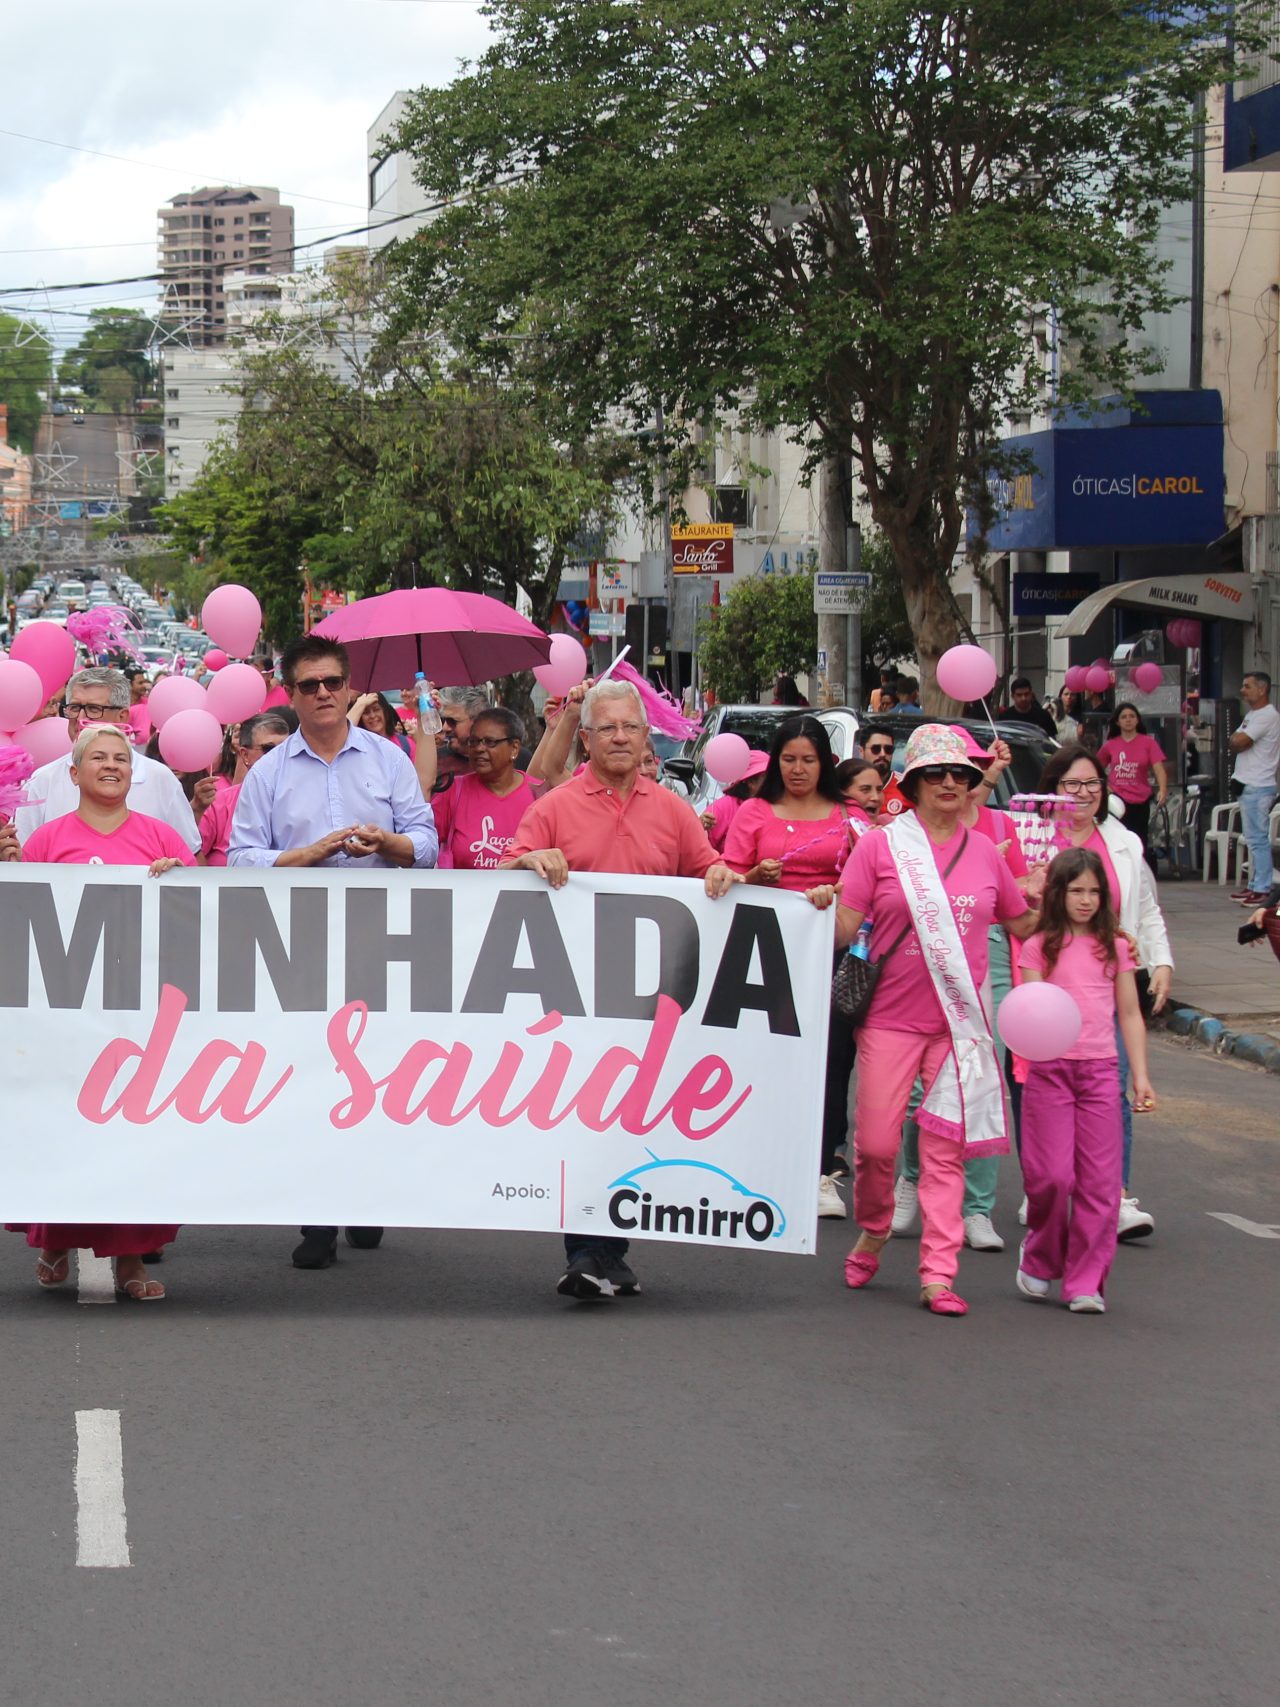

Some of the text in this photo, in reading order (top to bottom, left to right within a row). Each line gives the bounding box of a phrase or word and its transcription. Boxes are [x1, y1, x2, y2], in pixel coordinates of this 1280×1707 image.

[1072, 474, 1204, 496] ÓTICAS CAROL
[673, 540, 726, 564] Santo
[701, 564, 718, 572] Grill
[1148, 585, 1199, 606] MILK SHAKE
[1203, 576, 1243, 604] SORVETES
[896, 850, 931, 902] Madrinha
[916, 901, 940, 935] Rosa
[943, 974, 960, 987] de
[75, 982, 754, 1142] da Saúde
[491, 1182, 551, 1201] Apoio:
